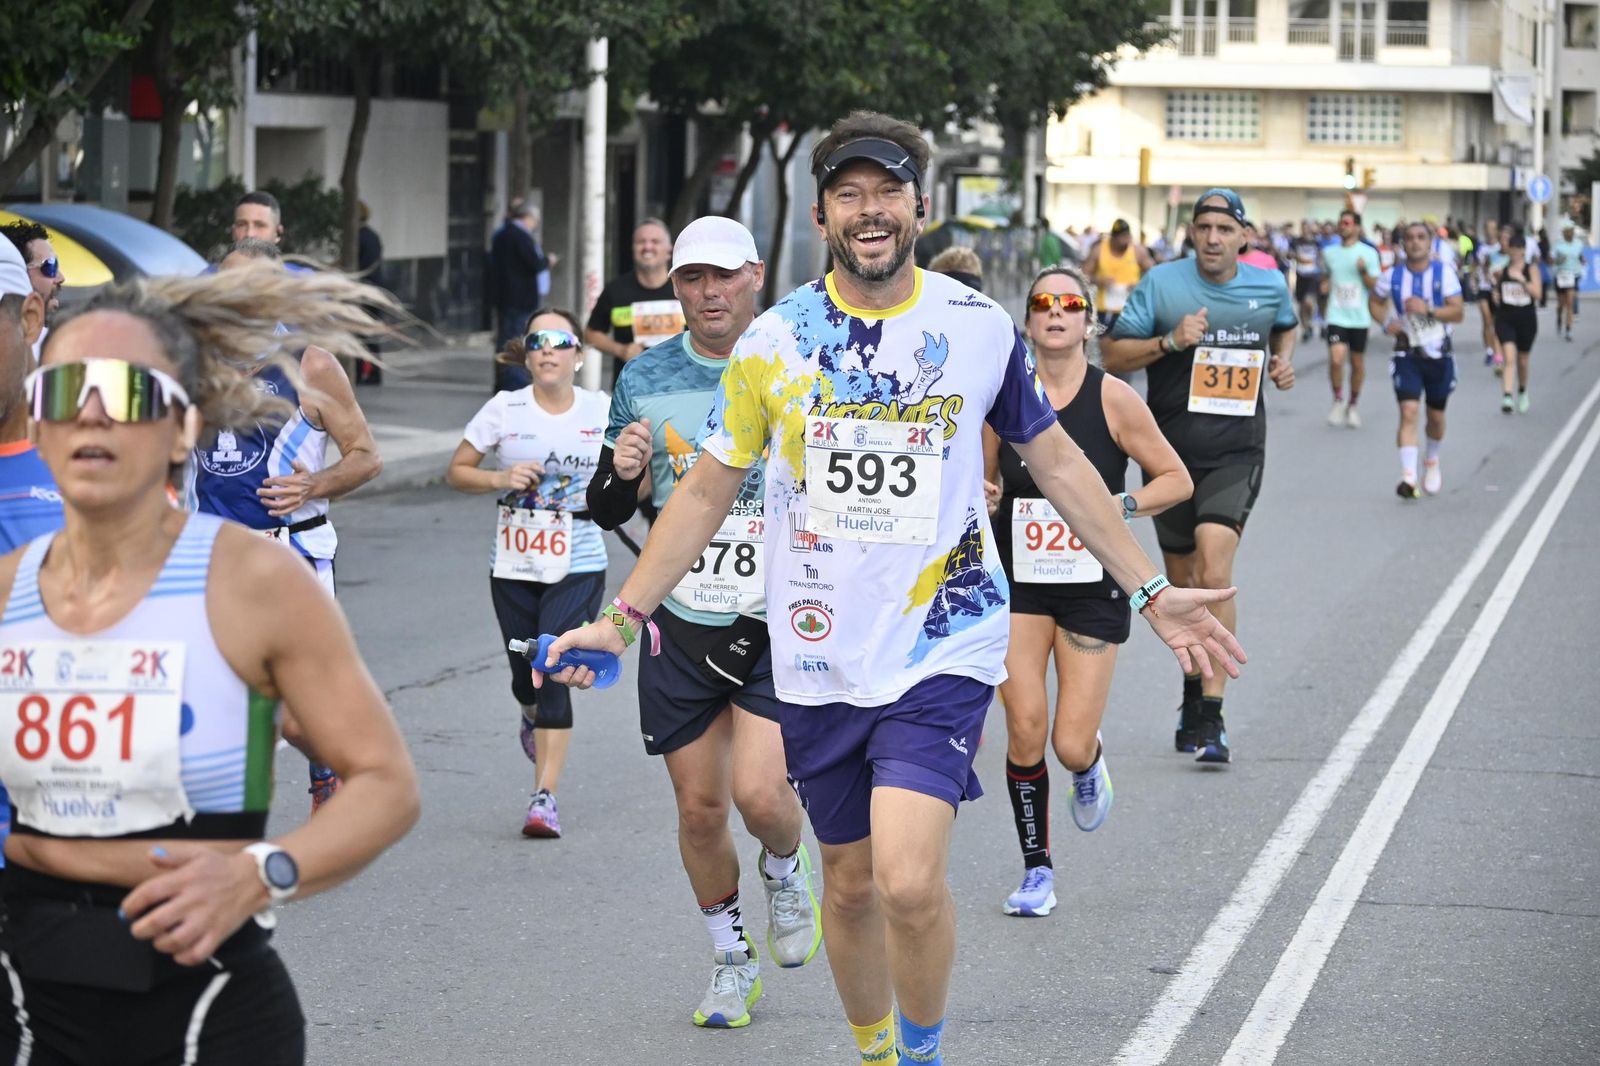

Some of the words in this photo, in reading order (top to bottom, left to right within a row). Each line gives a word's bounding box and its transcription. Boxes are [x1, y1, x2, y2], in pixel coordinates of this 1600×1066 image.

[948, 299, 993, 309] TEAMERGY
[1216, 329, 1260, 342] Bauista
[1203, 364, 1251, 391] 313
[807, 394, 963, 441] RMES
[812, 439, 839, 448] HUELVA
[826, 451, 917, 498] 593
[731, 500, 763, 509] ALOS
[846, 506, 873, 514] MARTIN
[836, 514, 894, 532] Huelva
[501, 526, 567, 557] 1046
[1025, 520, 1086, 552] 928
[1033, 565, 1073, 576] Huelva
[699, 582, 712, 590] RUIZ
[693, 590, 739, 605] Huelva
[788, 600, 802, 612] FRES
[729, 643, 747, 656] ipso
[14, 693, 136, 762] 861
[41, 792, 116, 818] Huelva
[1015, 781, 1039, 849] kalenji
